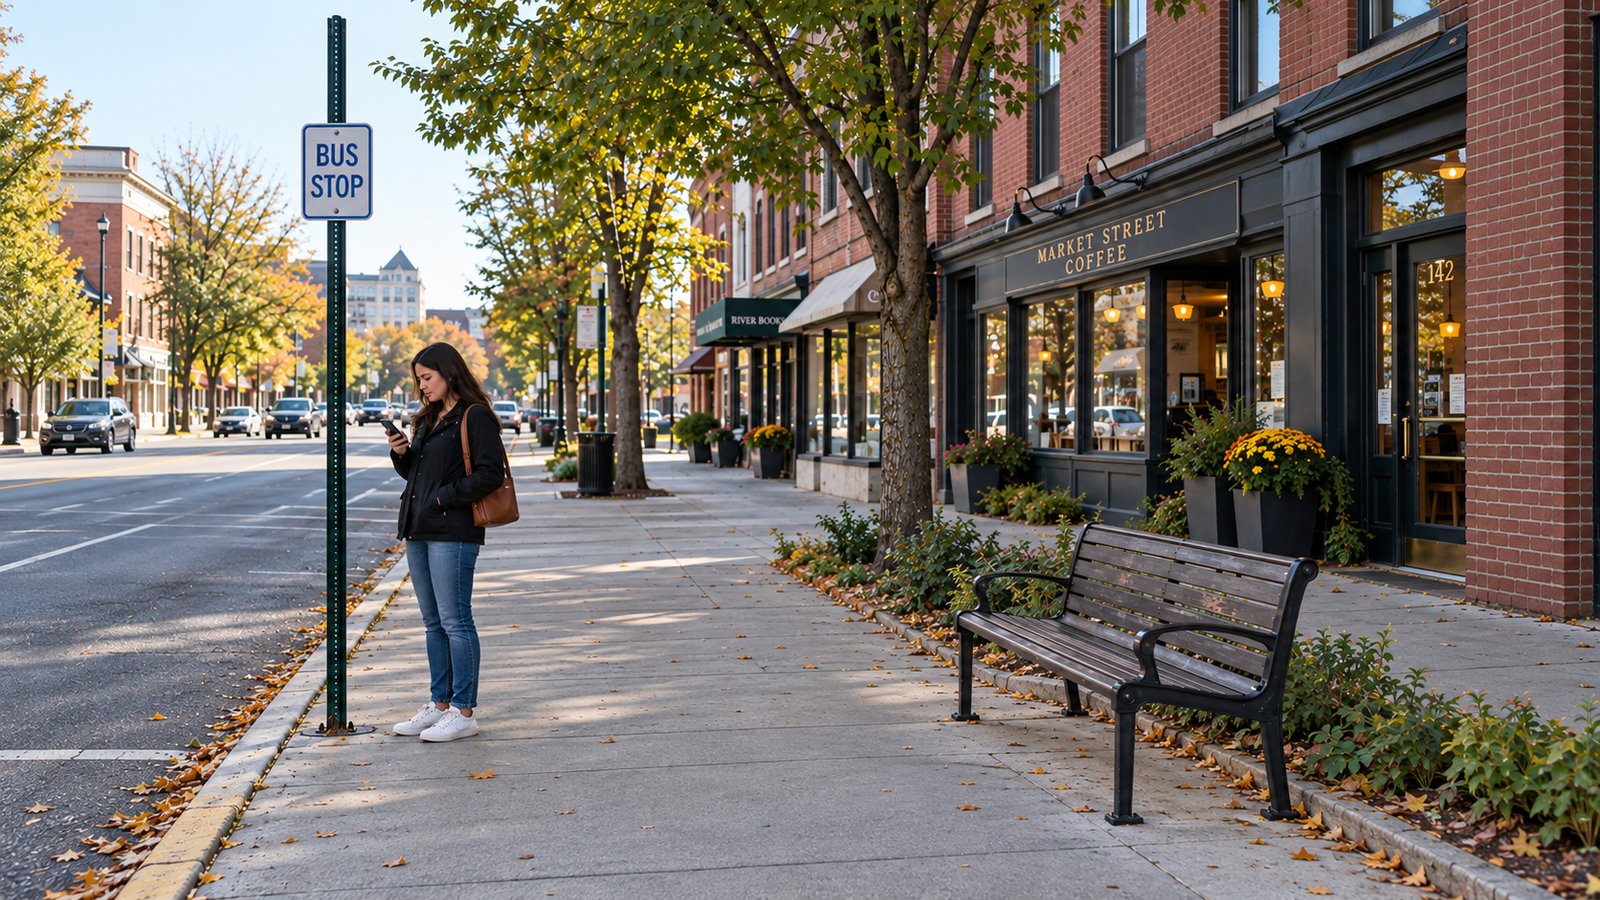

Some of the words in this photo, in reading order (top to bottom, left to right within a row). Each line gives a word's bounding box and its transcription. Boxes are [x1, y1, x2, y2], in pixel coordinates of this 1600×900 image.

[316, 143, 358, 167] BUS
[310, 174, 364, 198] STOP
[1037, 232, 1093, 264] MARKET
[1103, 209, 1166, 244] STREET
[1065, 243, 1127, 275] COFFEE
[1428, 259, 1454, 284] 142
[731, 316, 757, 325] RIVER
